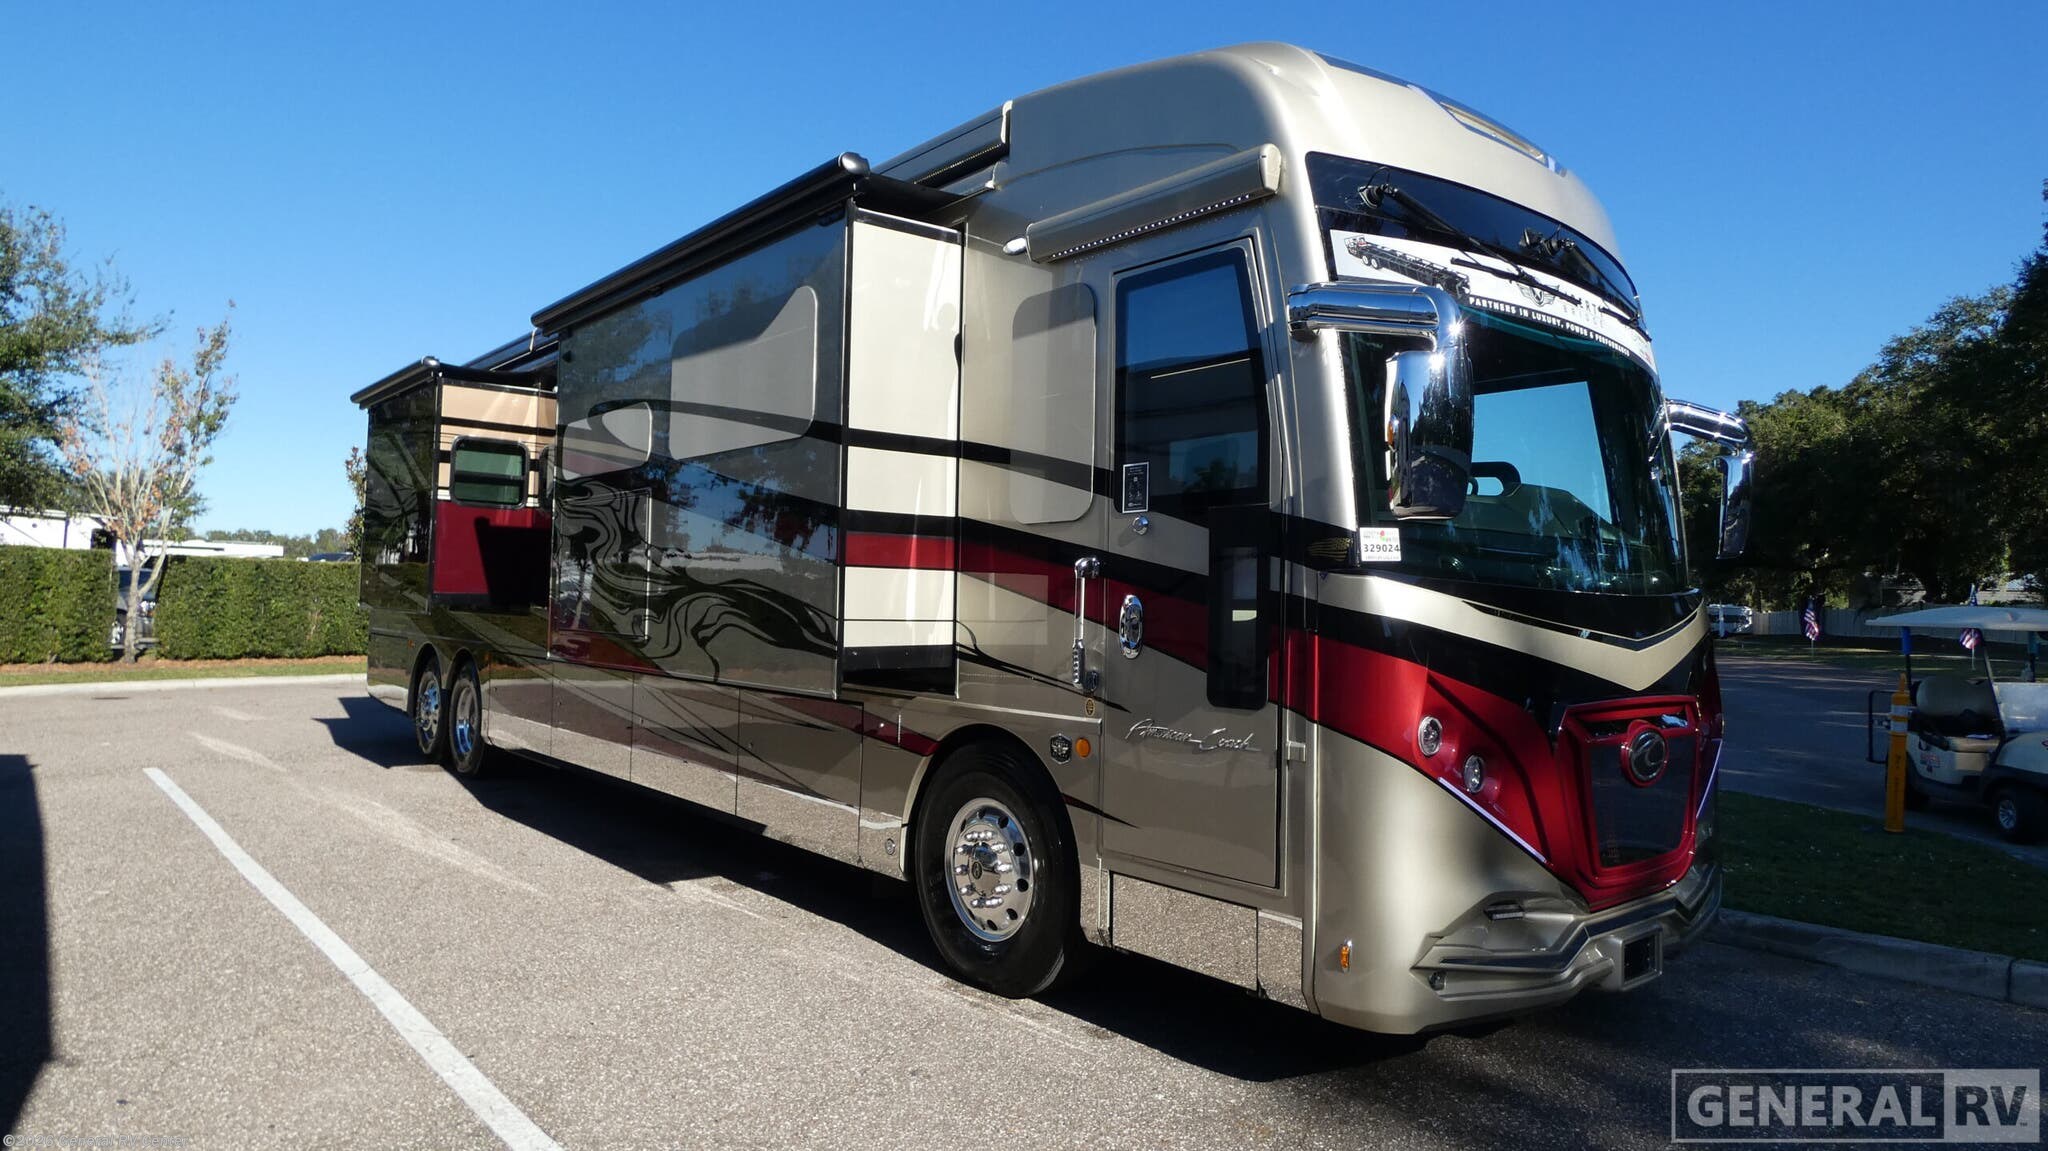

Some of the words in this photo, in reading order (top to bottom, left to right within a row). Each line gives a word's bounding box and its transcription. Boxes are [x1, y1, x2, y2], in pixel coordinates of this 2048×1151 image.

[1469, 297, 1516, 314] PARTNERS
[1520, 309, 1529, 318] IN
[1532, 312, 1564, 328] LUXURY,
[1566, 322, 1589, 337] POWER
[1363, 544, 1401, 552] 329024
